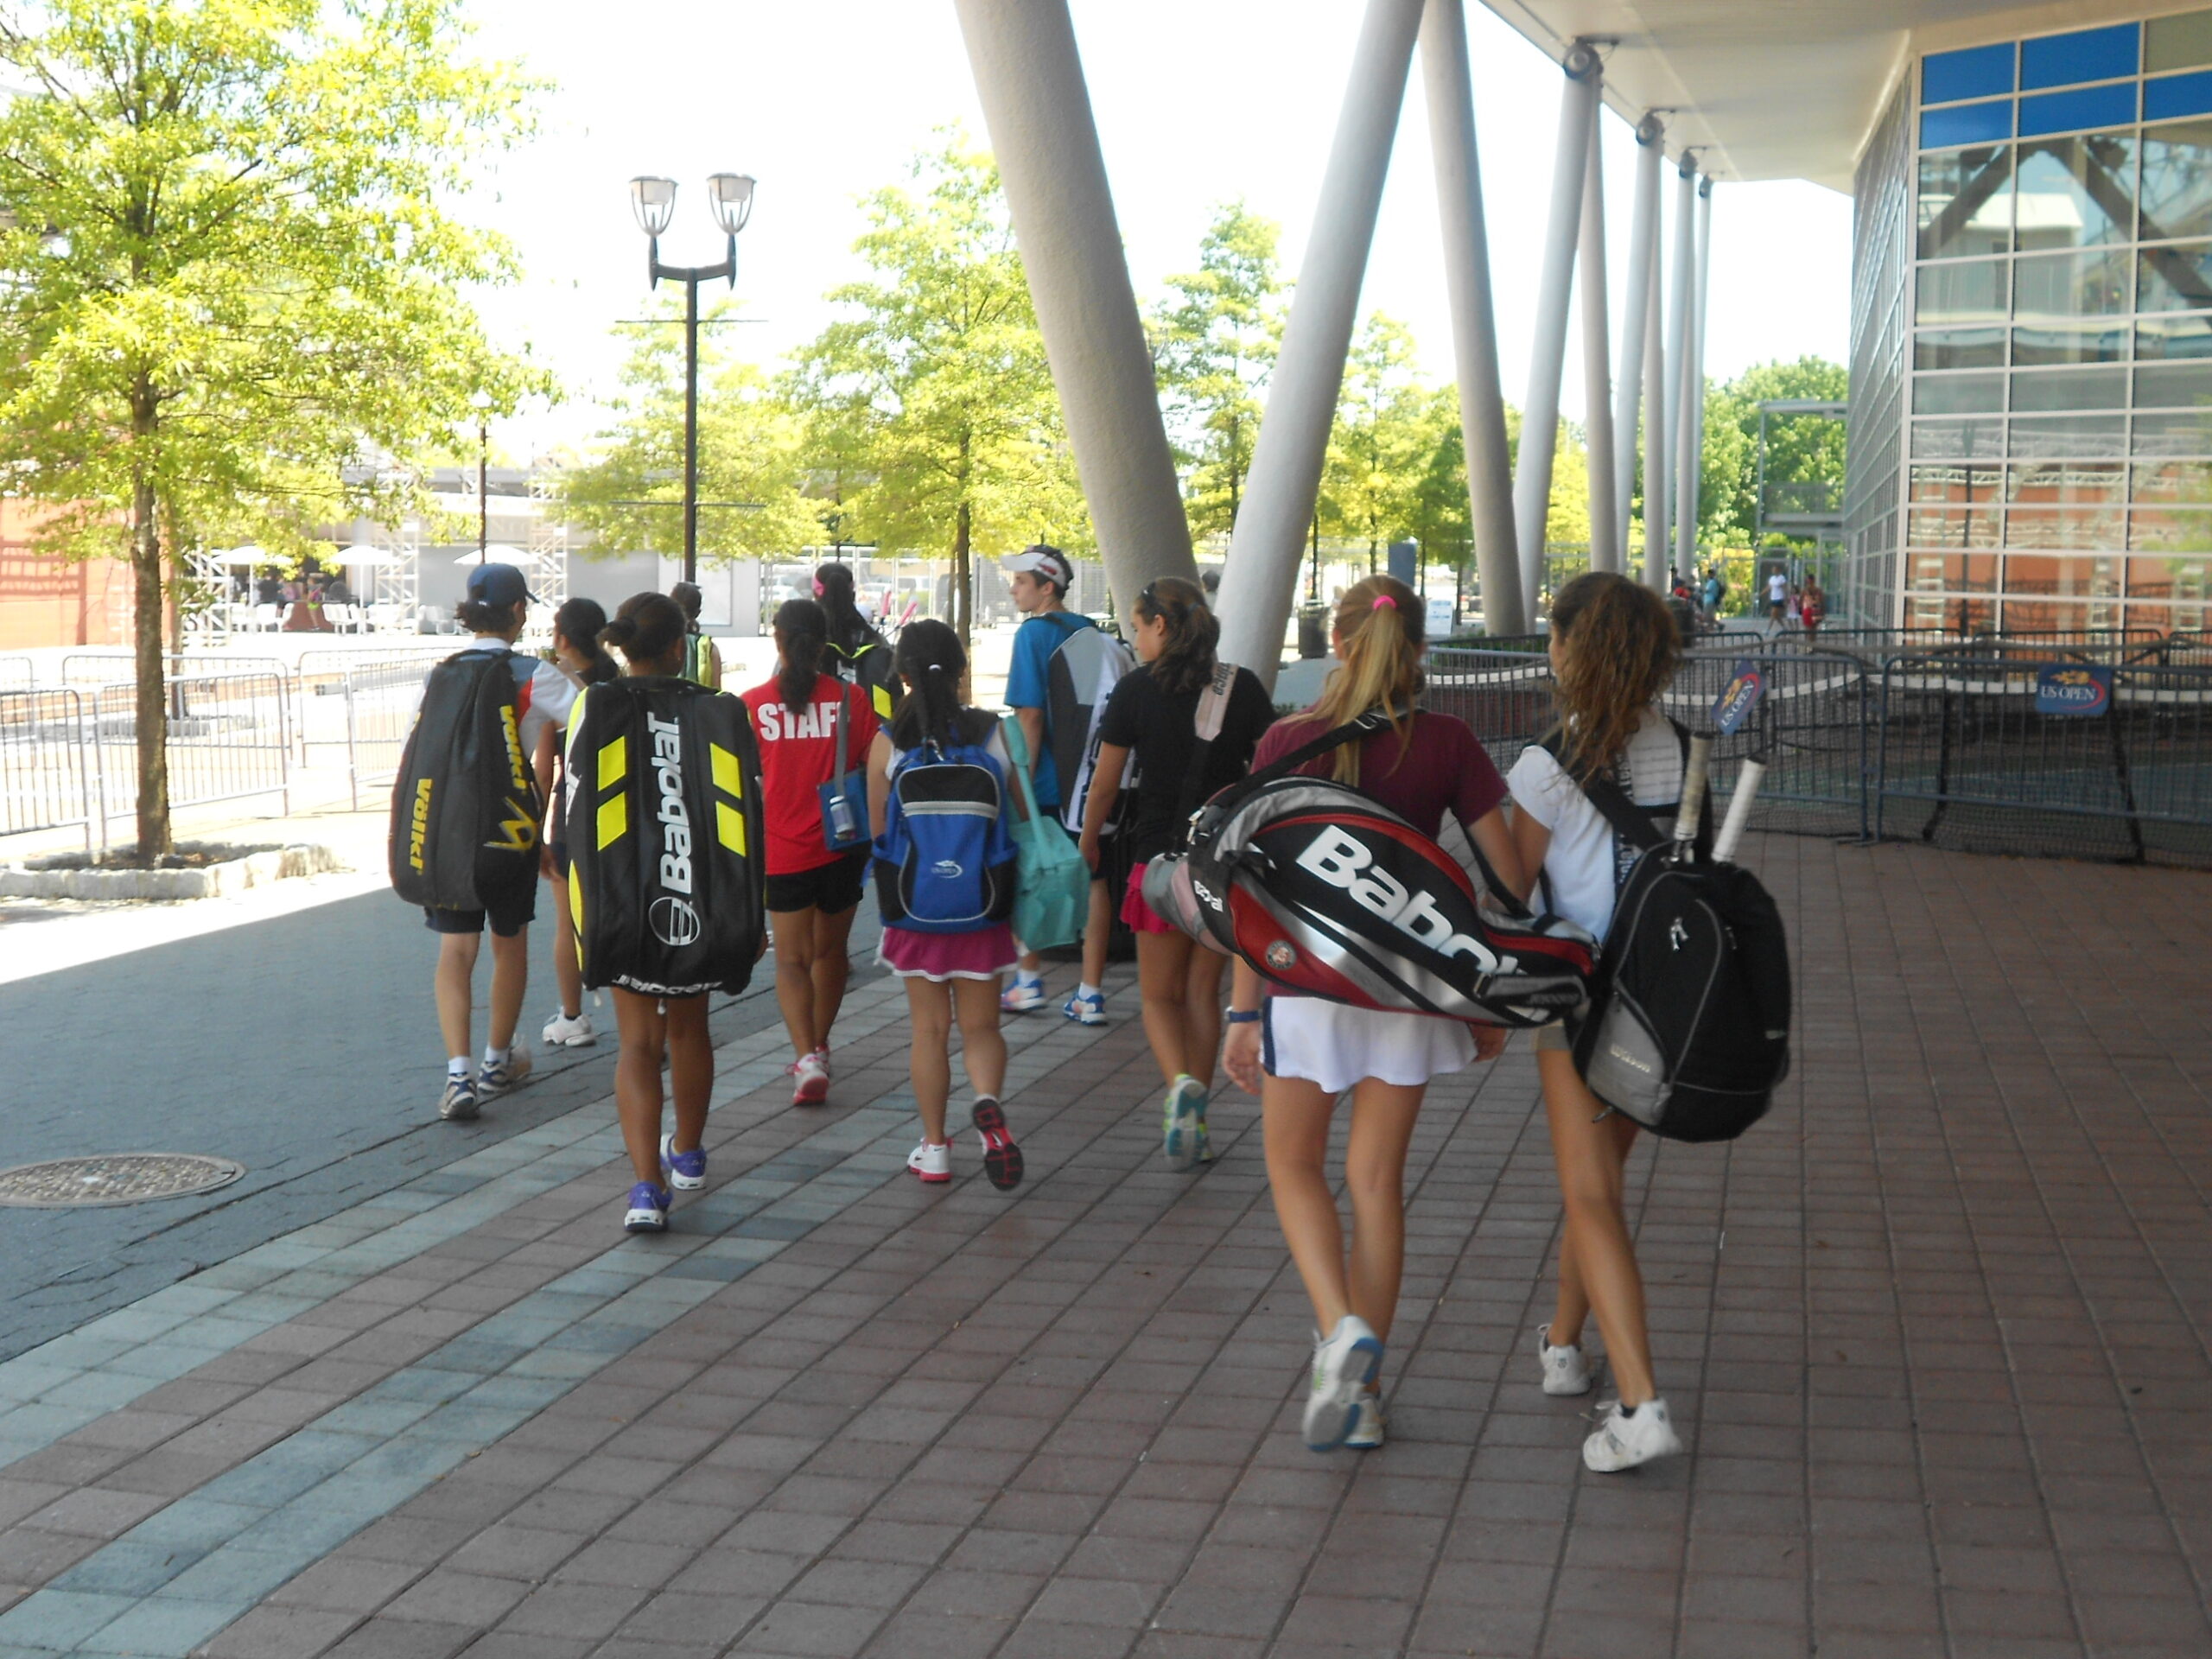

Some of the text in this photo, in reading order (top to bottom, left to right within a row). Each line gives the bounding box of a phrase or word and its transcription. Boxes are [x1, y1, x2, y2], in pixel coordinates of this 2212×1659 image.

[2041, 685, 2096, 701] US OPEN
[757, 701, 850, 741] STAF
